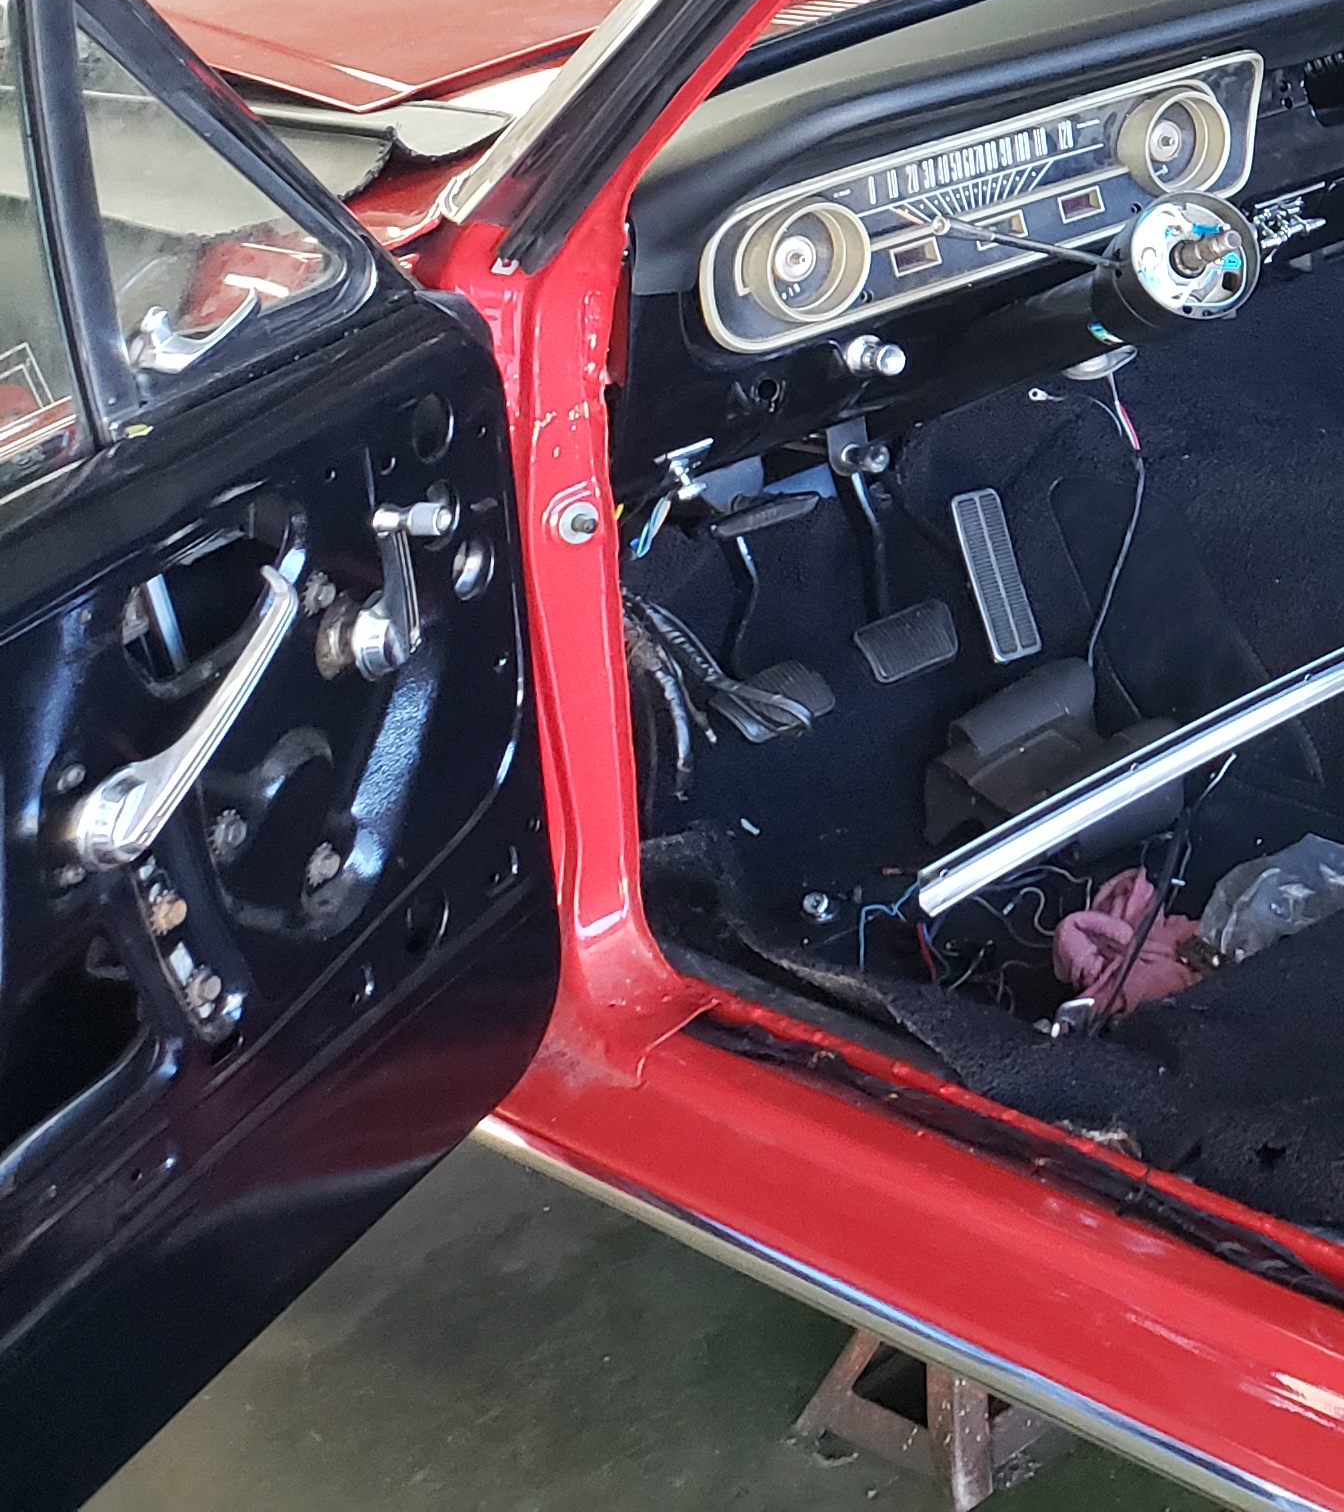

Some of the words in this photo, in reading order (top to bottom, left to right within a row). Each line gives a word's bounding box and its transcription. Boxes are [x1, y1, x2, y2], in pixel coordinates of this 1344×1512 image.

[868, 176, 877, 205] 0
[887, 169, 899, 199] 10
[906, 164, 920, 193] 20
[922, 159, 936, 189] 30
[937, 154, 950, 184] 40
[950, 151, 963, 181] 50
[962, 148, 976, 179] 60
[974, 144, 986, 175] 70
[984, 141, 999, 171] 80
[999, 136, 1013, 167] 90
[1014, 131, 1031, 162] 100
[1032, 126, 1048, 157] 110
[1058, 119, 1075, 150] 120
